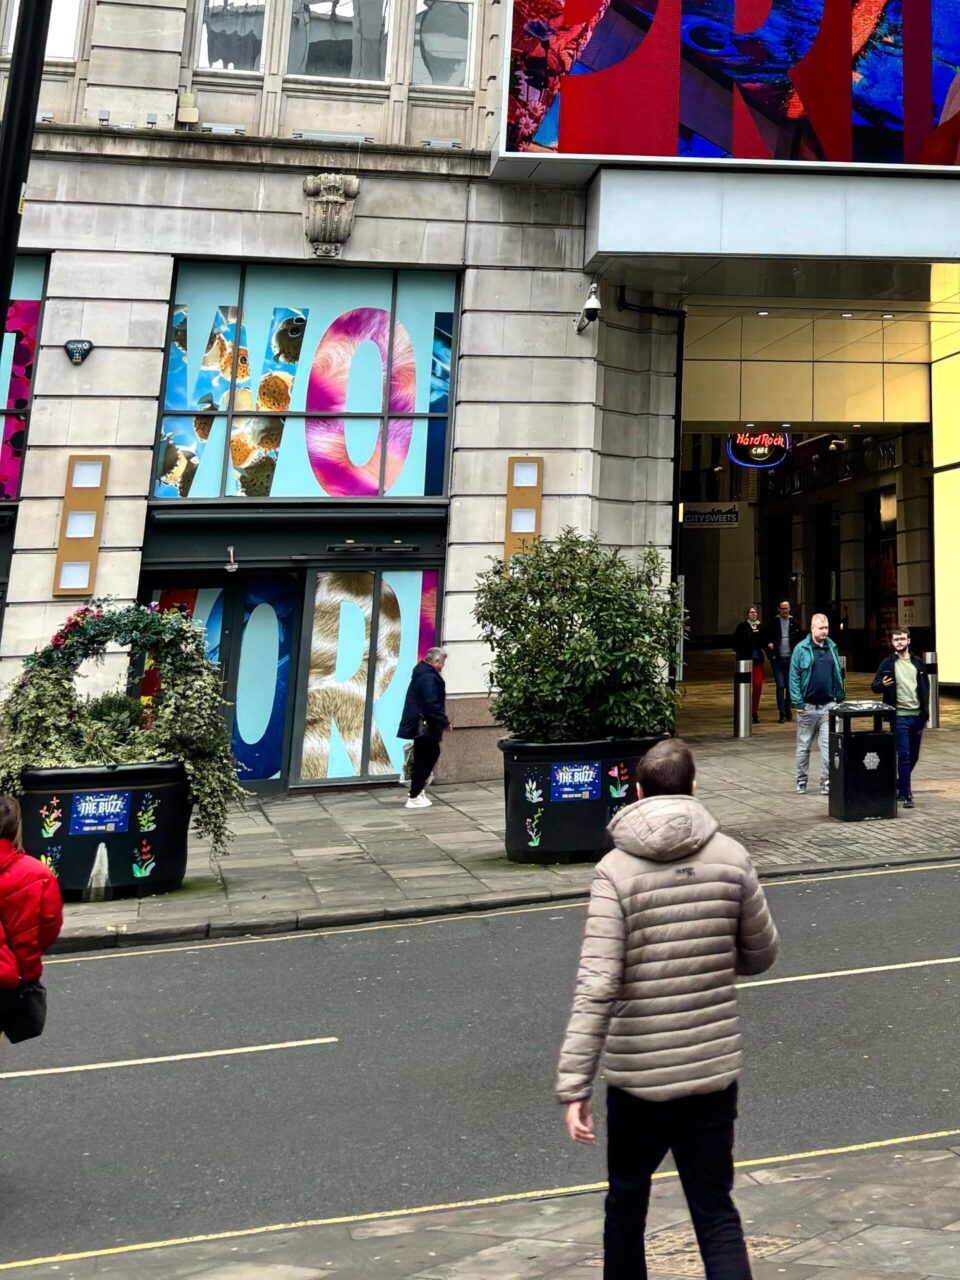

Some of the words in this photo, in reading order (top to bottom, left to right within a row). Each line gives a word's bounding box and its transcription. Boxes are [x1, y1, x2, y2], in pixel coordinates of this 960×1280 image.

[559, 771, 573, 784] THE
[574, 770, 594, 782] BUZZ
[80, 802, 97, 815] THE
[99, 800, 122, 813] BUZZ
